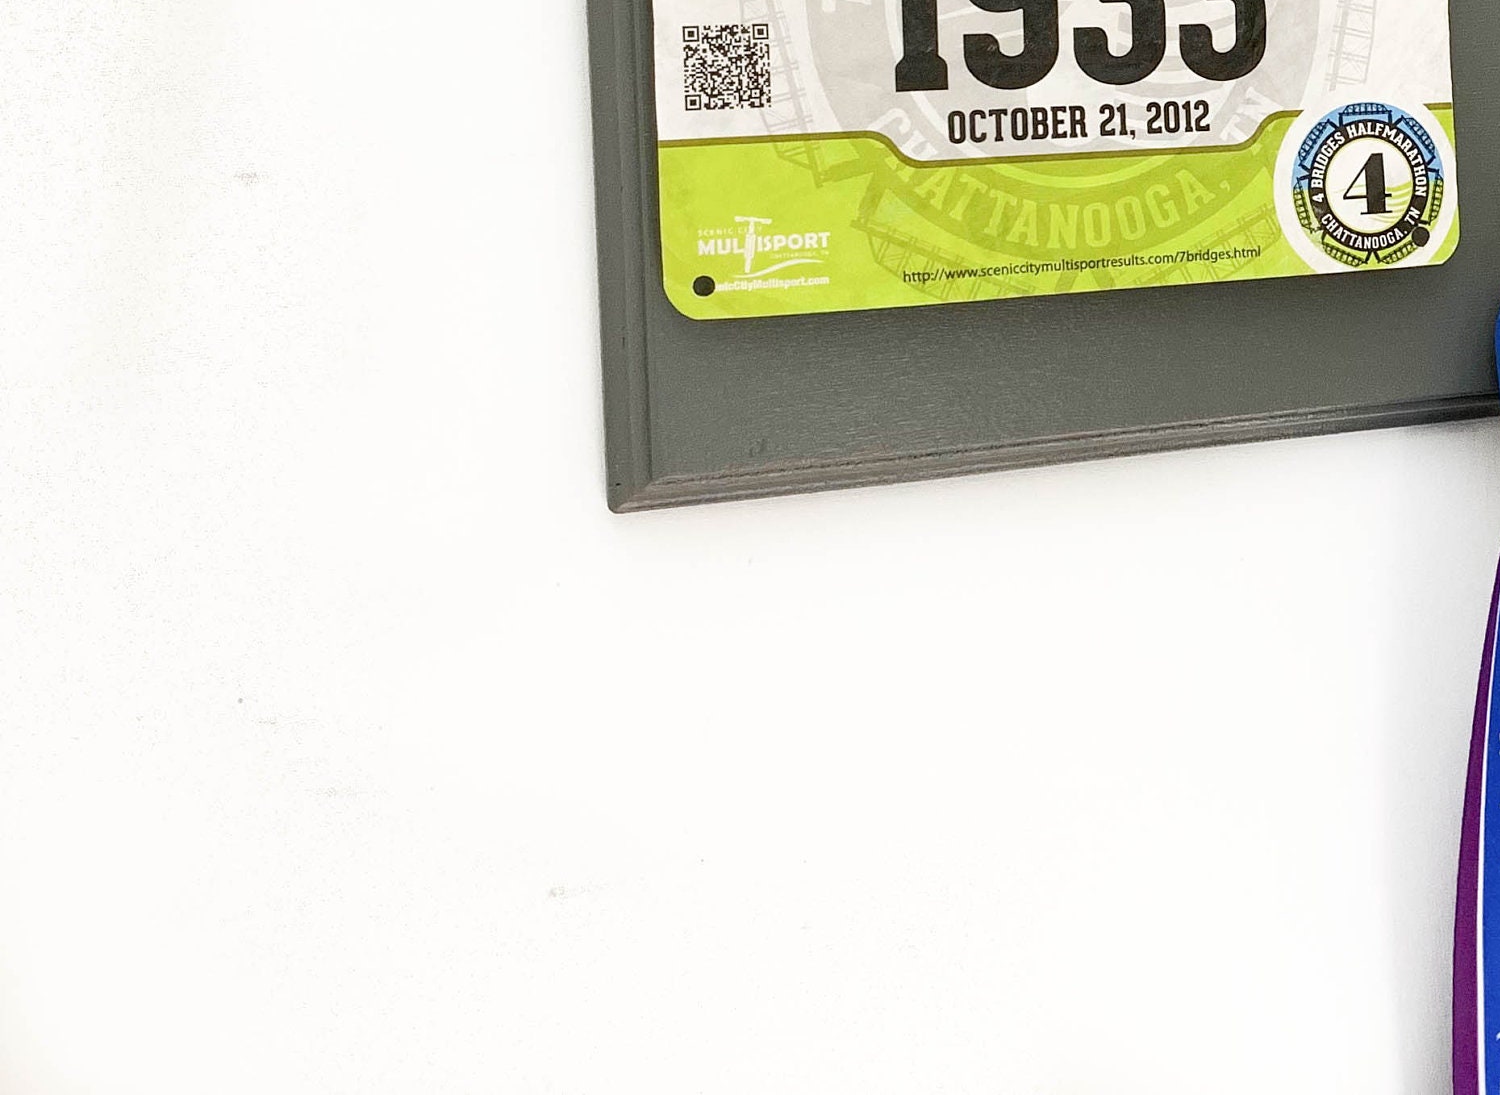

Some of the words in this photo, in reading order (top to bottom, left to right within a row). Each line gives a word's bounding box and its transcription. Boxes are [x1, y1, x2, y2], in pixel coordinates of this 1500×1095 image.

[947, 105, 1088, 145] OCTOBER
[1099, 102, 1137, 141] 21,
[1146, 98, 1211, 135] 2012
[1311, 131, 1346, 188] BRIDGES
[1345, 121, 1427, 197] HALFMARATHON
[1312, 193, 1325, 203] 4
[1342, 152, 1393, 216] 4
[737, 225, 763, 235] CIY
[1403, 206, 1421, 226] TN
[902, 246, 1262, 284] http://www.sceniccitymultisportresults.com/7bridges.html
